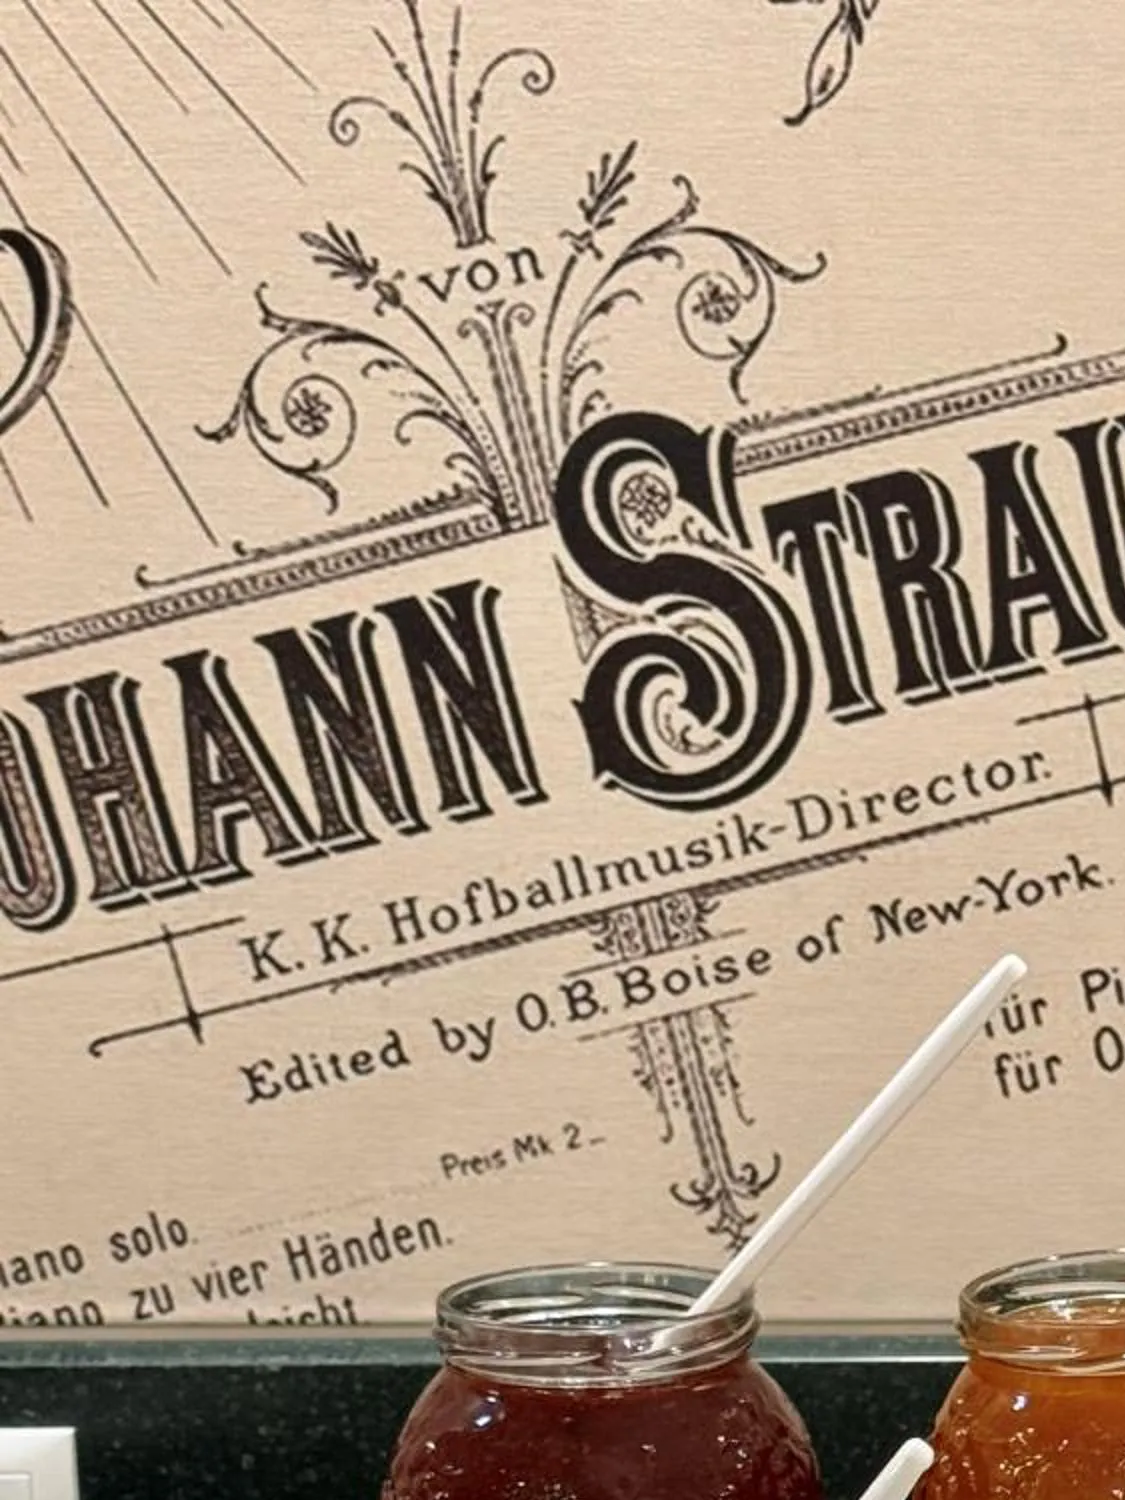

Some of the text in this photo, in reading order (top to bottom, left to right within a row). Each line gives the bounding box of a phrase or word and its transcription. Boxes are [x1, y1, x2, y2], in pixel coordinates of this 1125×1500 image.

[418, 245, 546, 302] von
[0, 580, 549, 933] OHANN
[383, 749, 1052, 946] Hofballmusik-Director.
[240, 1030, 411, 1104] Edited
[433, 1017, 496, 1063] by
[797, 914, 844, 964] of
[869, 854, 1115, 943] New-York.
[994, 1052, 1063, 1099] für
[440, 1151, 507, 1180] Preis
[0, 1243, 84, 1289] iano
[129, 1283, 174, 1320] zu
[192, 1259, 270, 1302] vier
[284, 1216, 454, 1282] Händen.
